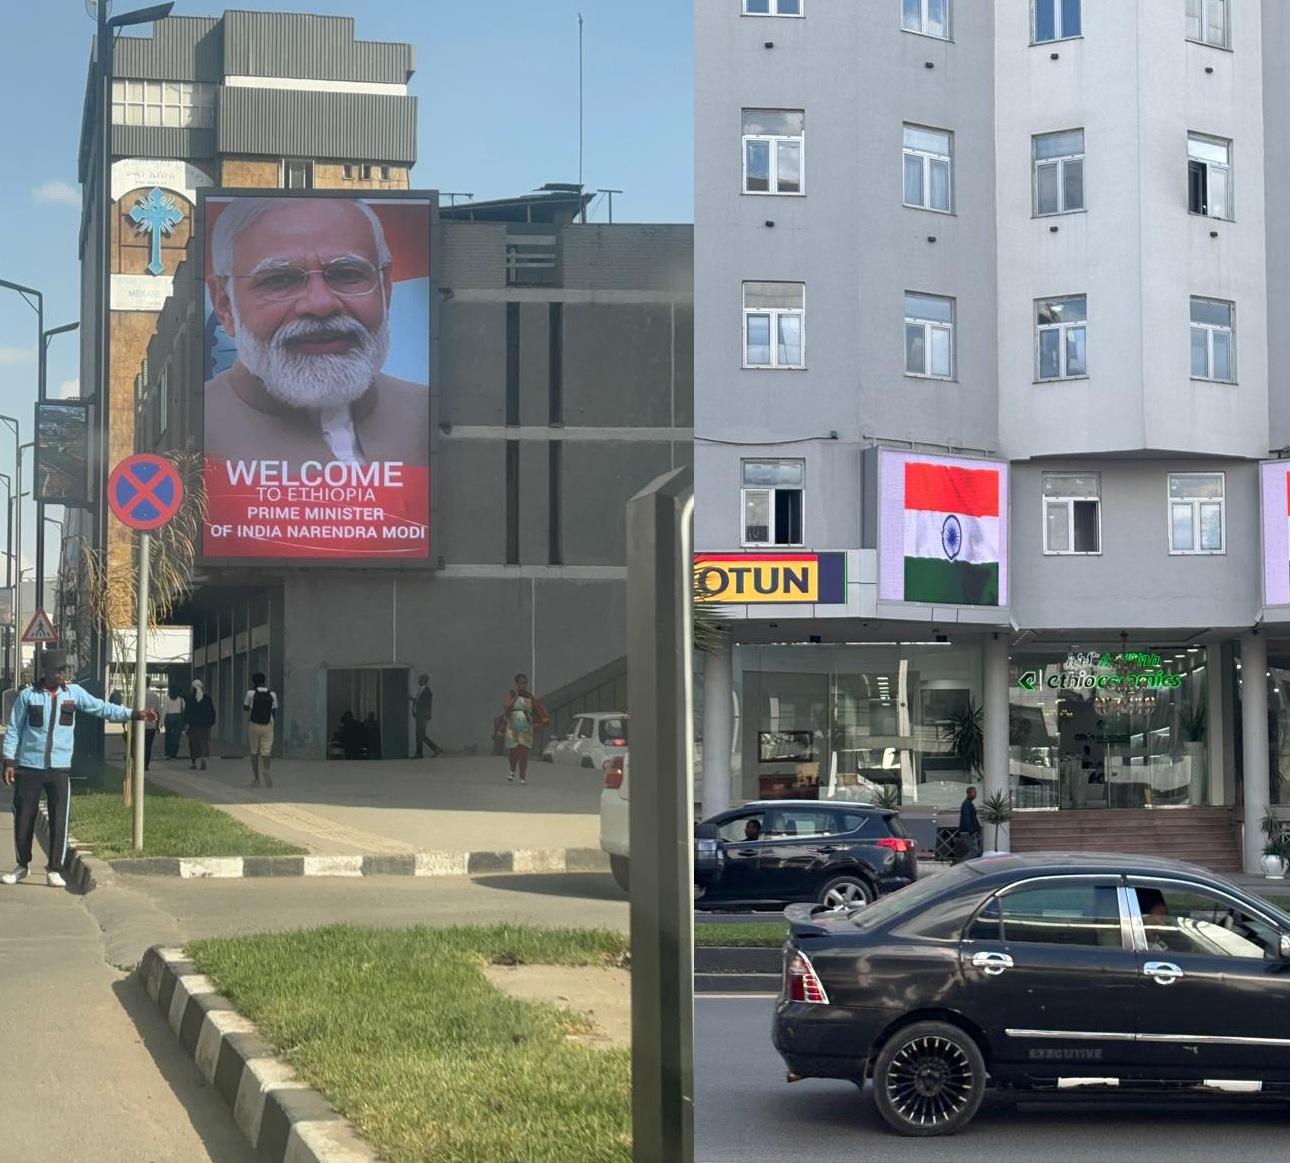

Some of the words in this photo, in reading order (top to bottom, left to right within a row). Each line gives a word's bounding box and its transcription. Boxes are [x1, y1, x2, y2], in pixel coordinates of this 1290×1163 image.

[226, 460, 403, 487] WELCOME
[256, 487, 281, 501] TO
[288, 487, 376, 502] ETHIOPIA
[248, 507, 300, 520] PRIME
[305, 507, 384, 521] MINISTER
[211, 525, 232, 537] OF
[238, 525, 281, 538] INDIA
[287, 526, 377, 538] NARENDRA
[383, 526, 424, 539] MODI
[1047, 670, 1184, 690] ethioceamics
